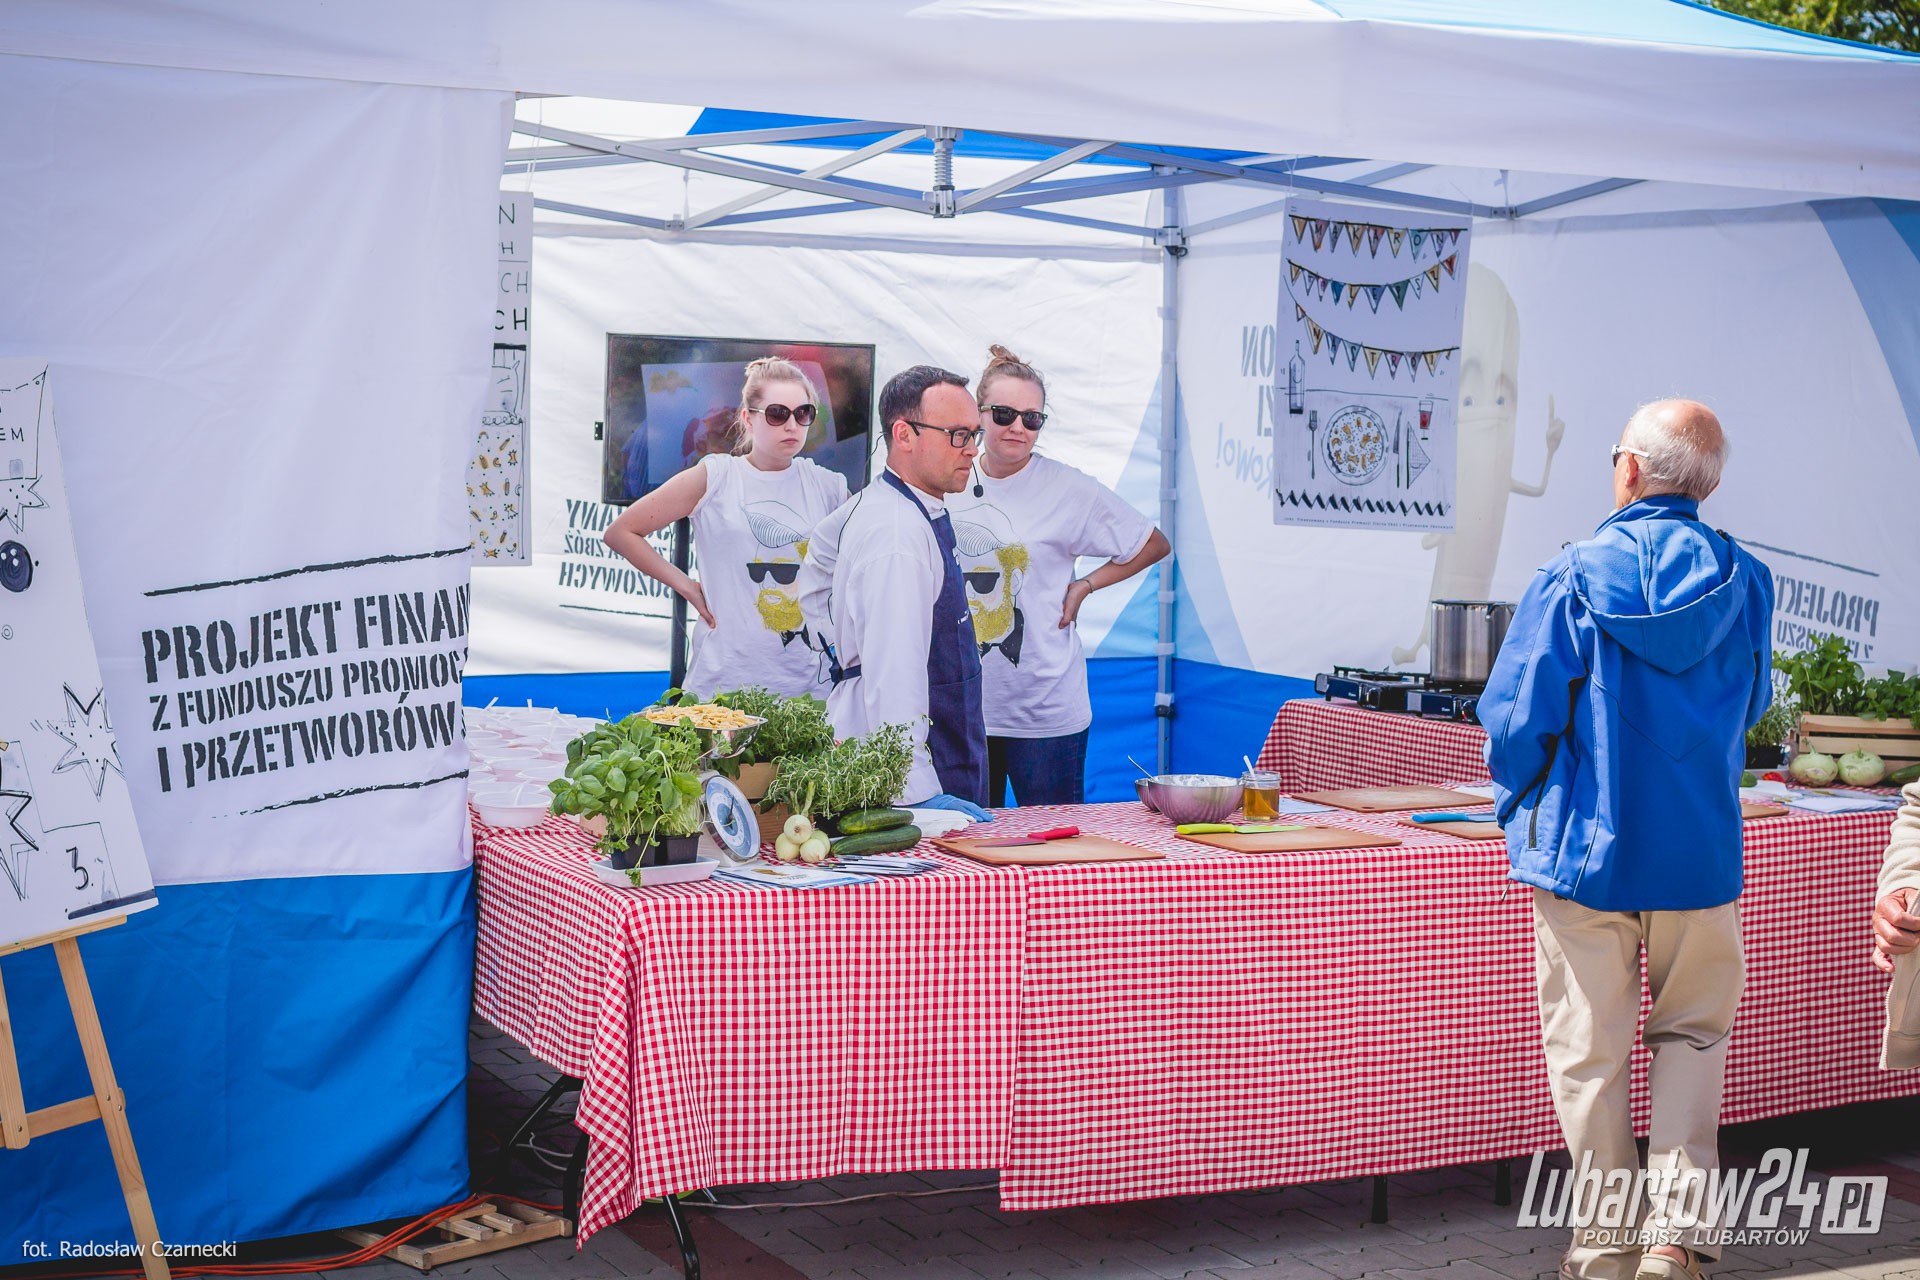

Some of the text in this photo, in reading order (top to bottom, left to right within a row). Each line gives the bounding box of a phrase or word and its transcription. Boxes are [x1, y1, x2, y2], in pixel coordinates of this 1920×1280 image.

[142, 600, 342, 684] PROJEKT
[149, 695, 171, 732] Z
[177, 666, 333, 728] FUNDUSZU
[157, 746, 172, 793] I
[182, 691, 456, 789] PRZETWORÓW
